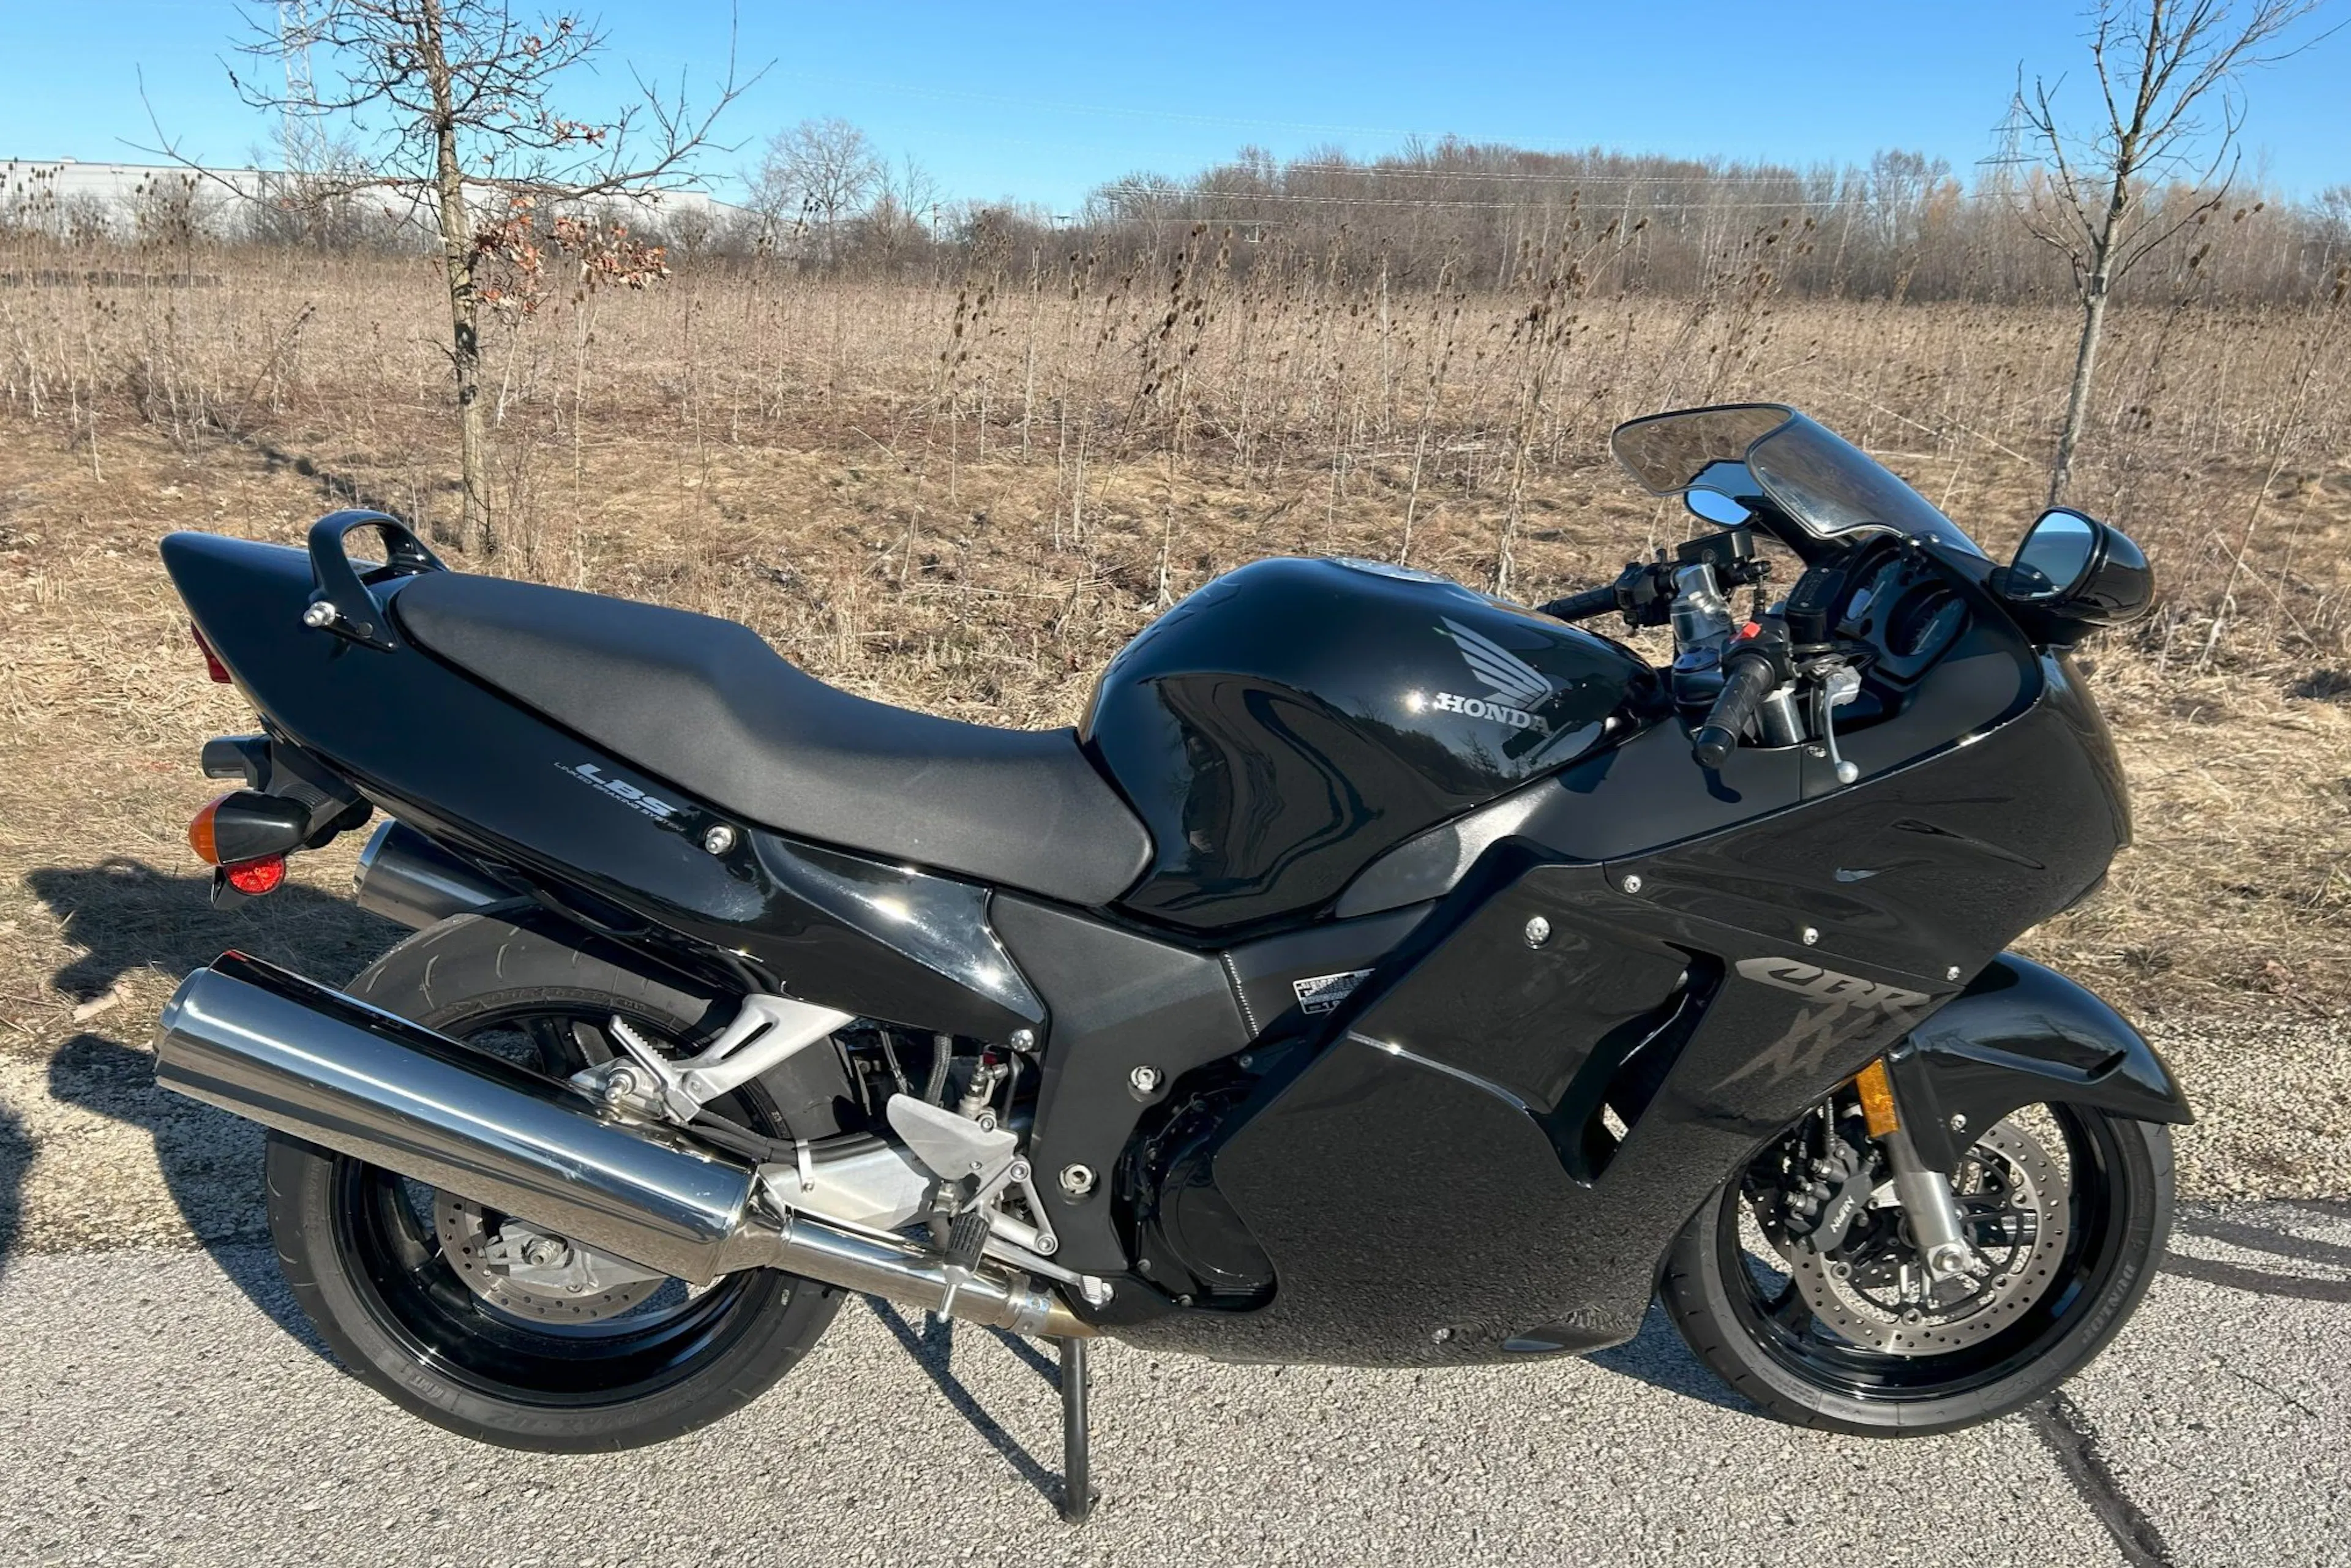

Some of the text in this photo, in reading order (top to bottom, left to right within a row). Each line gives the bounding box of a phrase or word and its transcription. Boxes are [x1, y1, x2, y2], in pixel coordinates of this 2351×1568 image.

[1433, 692, 1554, 737] HONDA
[576, 763, 678, 817] LBS
[1734, 956, 1932, 1030] CBR
[2082, 1261, 2137, 1345] DUNLOP
